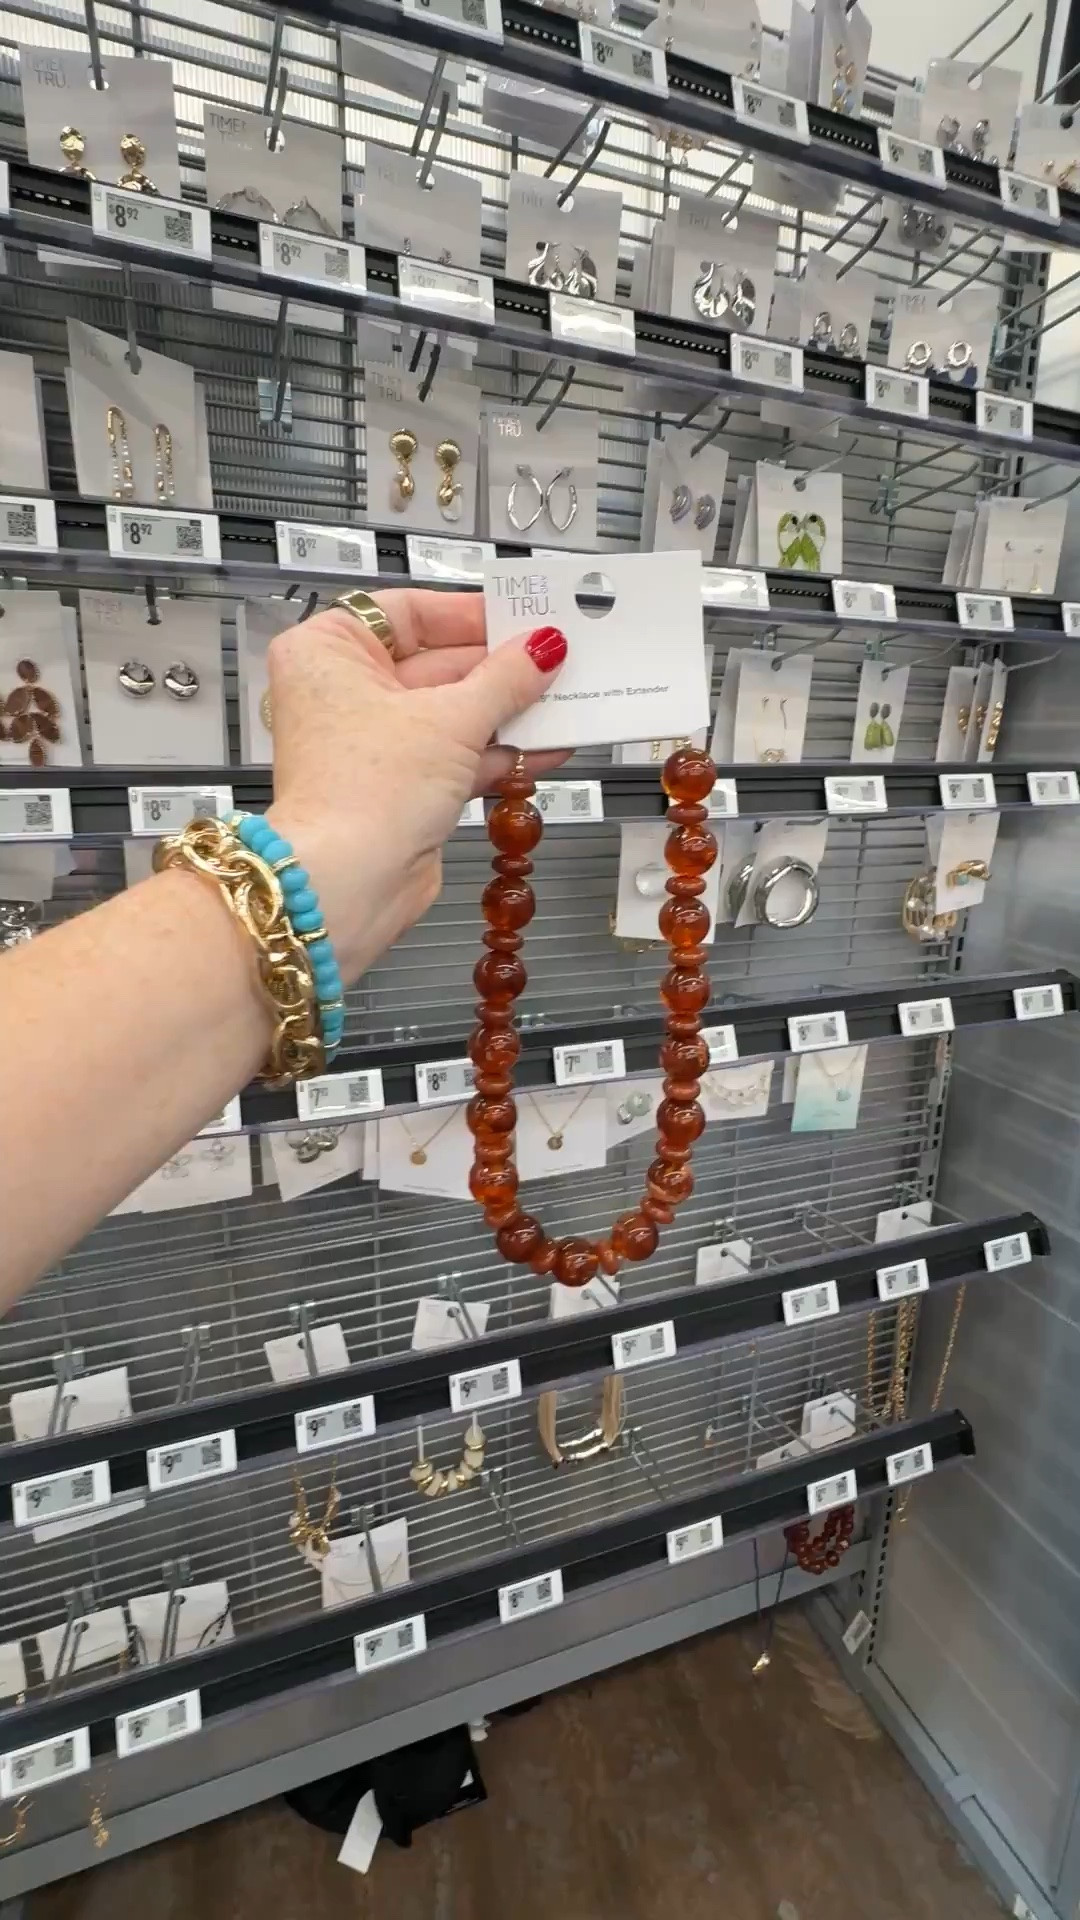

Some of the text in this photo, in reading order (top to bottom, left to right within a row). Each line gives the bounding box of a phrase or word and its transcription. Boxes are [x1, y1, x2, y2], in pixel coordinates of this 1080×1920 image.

[491, 575, 539, 597] TIME
[507, 596, 549, 617] TRU
[554, 691, 600, 702] Necklace
[604, 688, 624, 697] with
